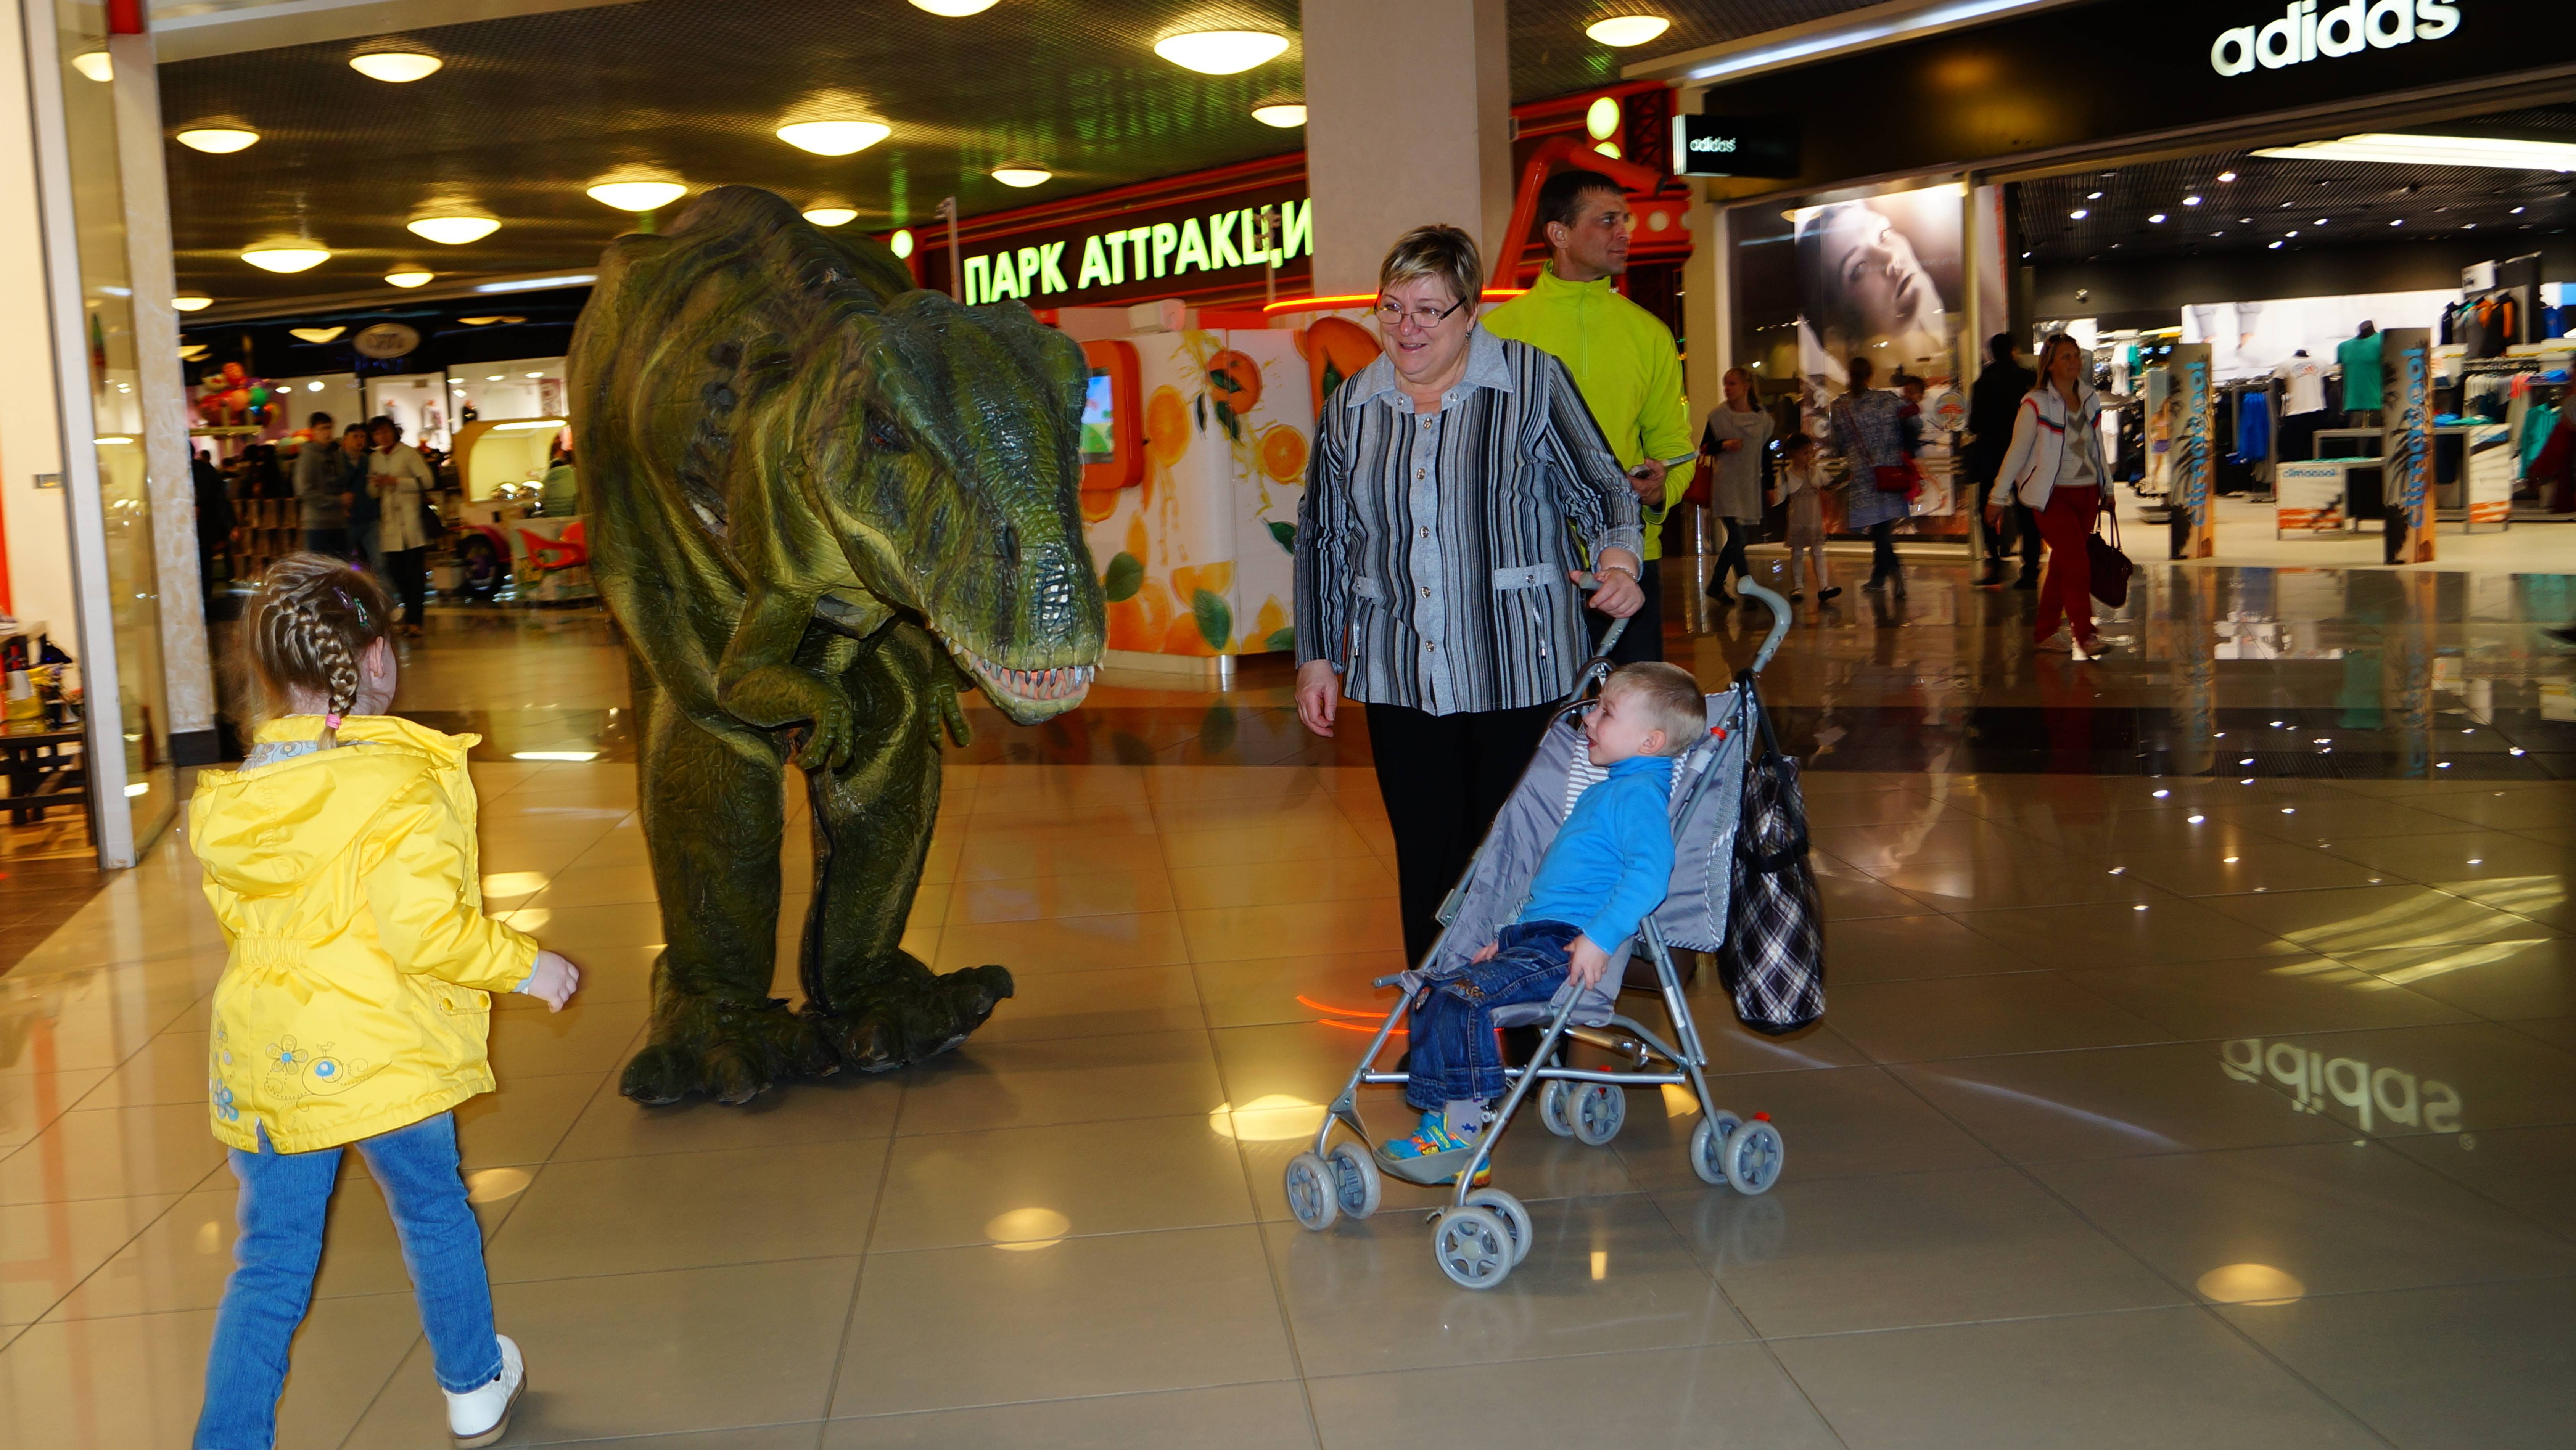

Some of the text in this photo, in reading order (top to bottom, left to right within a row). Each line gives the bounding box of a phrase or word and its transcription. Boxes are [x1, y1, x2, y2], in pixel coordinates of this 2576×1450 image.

[2211, 0, 2460, 77] adidas
[1689, 136, 1736, 152] adidas
[964, 197, 1313, 306] ПАРК АТТРАКЦИ
